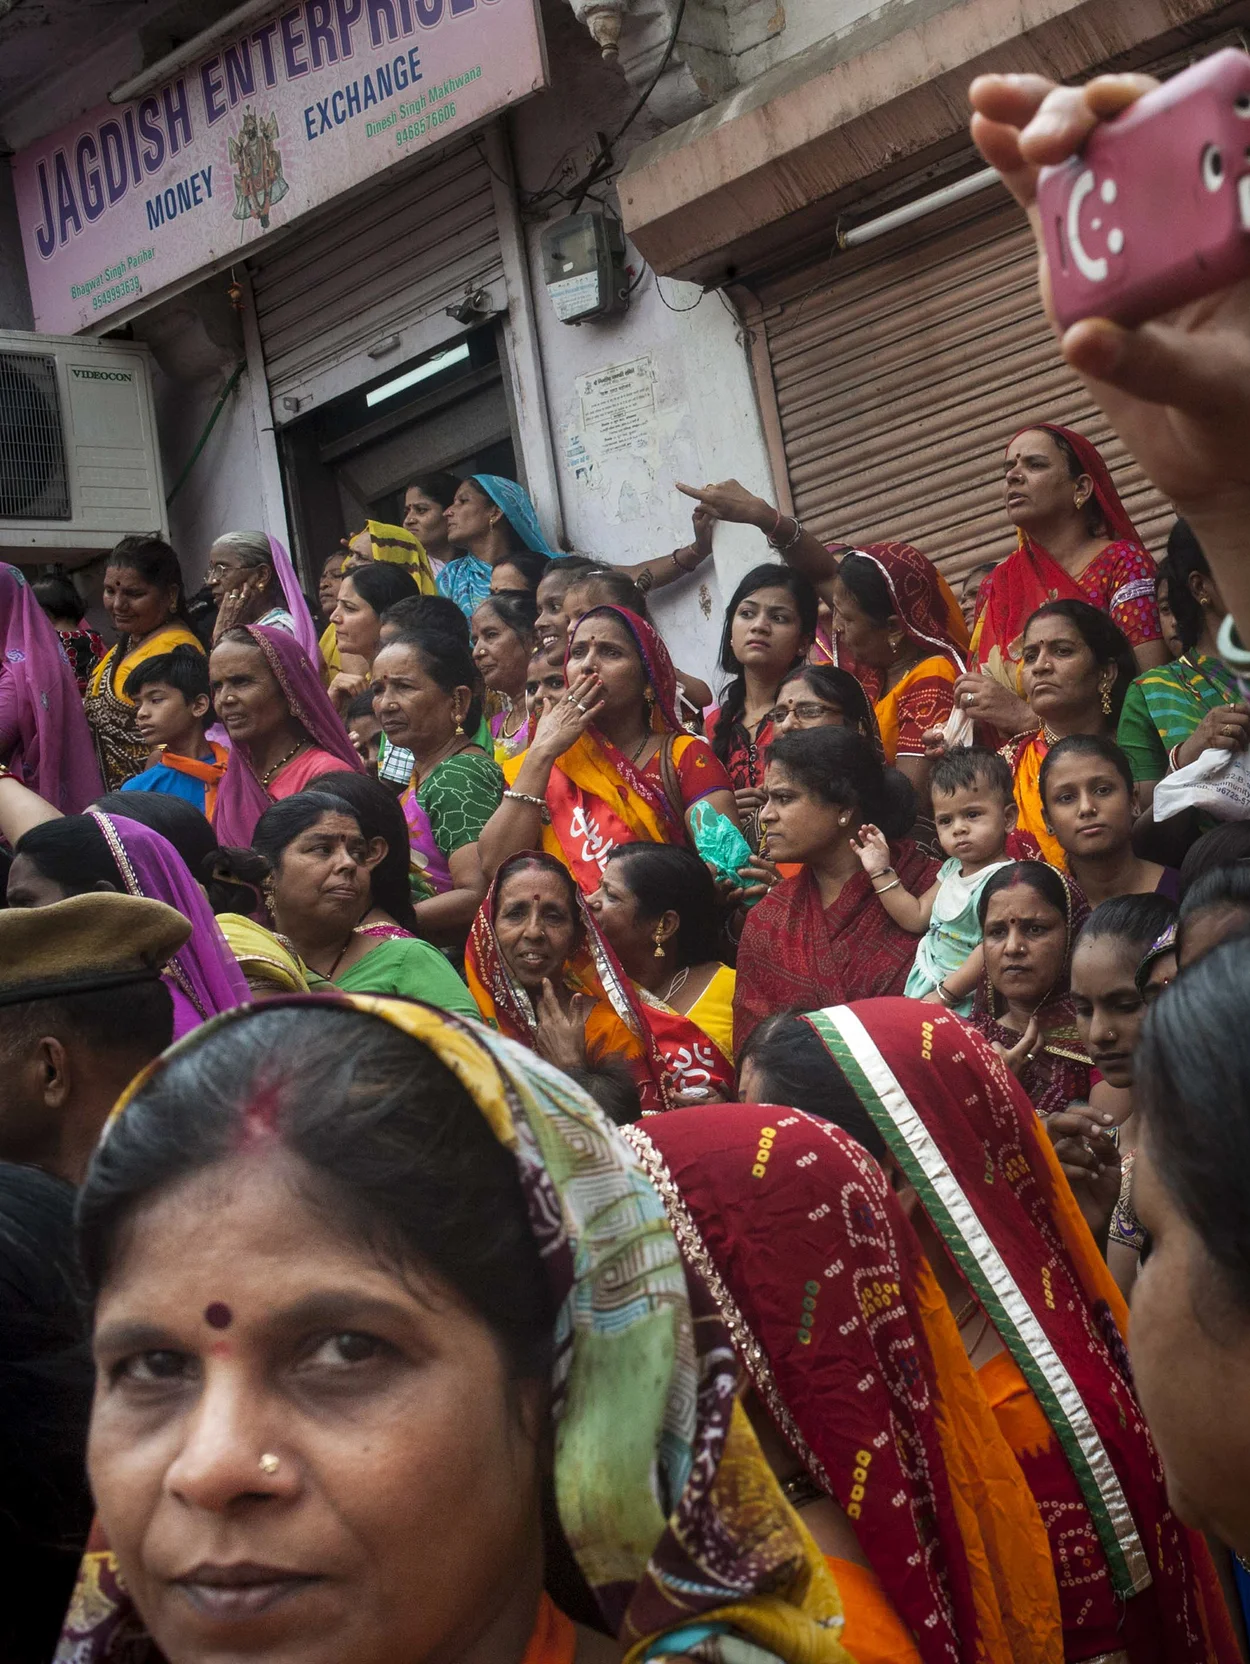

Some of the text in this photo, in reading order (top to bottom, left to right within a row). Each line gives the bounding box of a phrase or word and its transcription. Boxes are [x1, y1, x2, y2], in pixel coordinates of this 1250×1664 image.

[366, 65, 482, 138] Dinesh Singh Makhwana
[395, 102, 457, 146] 9468576606
[35, 0, 500, 260] JAGDISH ENTERPRI
[145, 46, 423, 231] MONEY EXCHANGE
[70, 247, 155, 299] Bhagwat Singh Parihar
[92, 276, 140, 310] 9549993639
[72, 369, 132, 382] VIDEOCON
